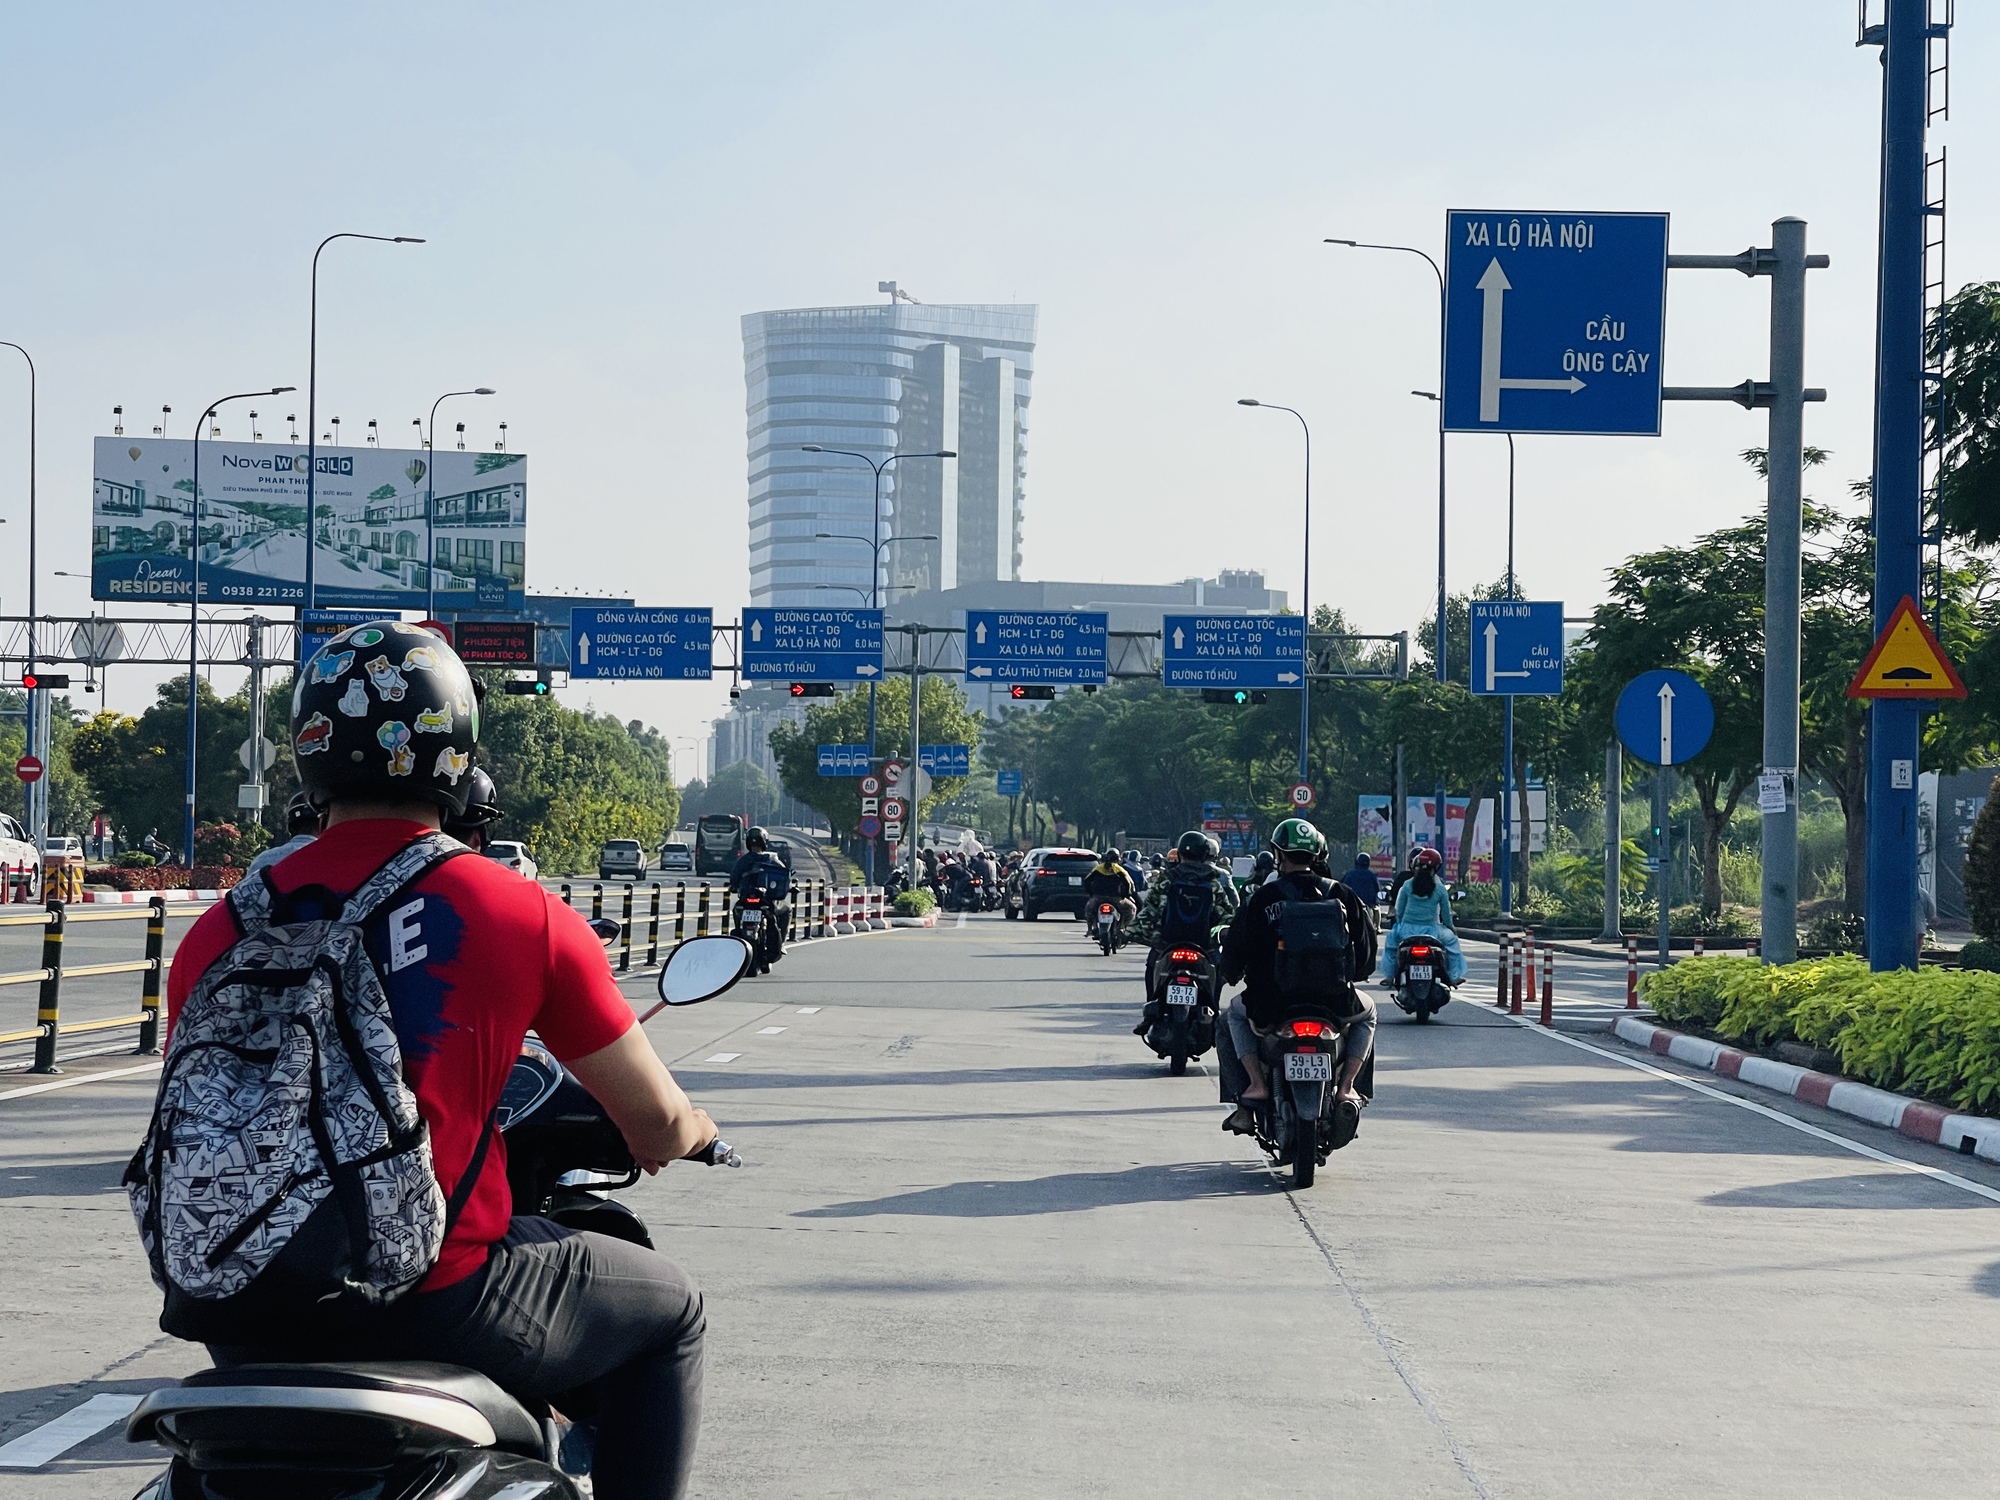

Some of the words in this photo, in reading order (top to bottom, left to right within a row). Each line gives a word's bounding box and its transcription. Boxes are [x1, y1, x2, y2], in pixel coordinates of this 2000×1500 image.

[1466, 222, 1490, 247] XA
[1496, 218, 1521, 251] LỘ
[1527, 217, 1554, 248] HÀ
[1560, 219, 1594, 253] NỘI
[1585, 314, 1626, 342] CẦU
[1562, 348, 1605, 373] ÔNG
[1611, 349, 1650, 377] CẬY
[258, 476, 286, 485] PHAN
[288, 477, 309, 486] THI
[134, 559, 182, 581] Ocean
[110, 579, 208, 595] RESIDENCE
[222, 586, 254, 596] 0938
[257, 587, 277, 597] 221
[281, 587, 304, 598] 226
[627, 612, 649, 624] VĂN
[651, 610, 679, 624] CỐNG
[684, 614, 696, 624] 4.0
[697, 614, 710, 624] km
[774, 611, 810, 623] ĐƯỜNG
[812, 613, 833, 623] CAO
[835, 610, 854, 623] TỐC
[1476, 606, 1487, 617] XA
[1489, 604, 1501, 619] LỘ
[1502, 604, 1514, 617] HÀ
[1516, 604, 1531, 619] NỘI
[855, 620, 867, 630] 4.5
[868, 620, 881, 630] km
[998, 613, 1034, 625] ĐƯỜNG
[1036, 615, 1057, 626] CAO
[1059, 613, 1078, 626] TỐC
[1195, 617, 1231, 630] ĐƯỜNG
[1233, 620, 1254, 630] CAO
[1256, 617, 1275, 630] TỐC
[774, 625, 797, 635] HCM
[806, 625, 817, 635] LT
[826, 625, 840, 635] DG
[998, 629, 1020, 639] HCM
[1030, 629, 1042, 639] LT
[1050, 630, 1065, 639] DG
[1078, 624, 1090, 634] 4.5
[1092, 625, 1105, 635] km
[1275, 627, 1288, 637] 4.5
[1289, 627, 1302, 637] km
[596, 632, 632, 644] ĐƯỜNG
[634, 634, 655, 644] CAO
[657, 631, 677, 644] TỐC
[775, 638, 788, 648] XA
[790, 636, 804, 650] LỘ
[806, 636, 820, 648] HÀ
[823, 638, 840, 650] NỘI
[854, 639, 867, 649] 6.0
[868, 639, 881, 649] km
[1195, 633, 1218, 642] HCM
[1227, 633, 1238, 643] LT
[1248, 633, 1262, 643] DG
[596, 646, 619, 657] HCM
[628, 647, 640, 657] LT
[649, 647, 663, 657] DG
[683, 641, 696, 651] 4.5
[697, 641, 710, 651] km
[999, 645, 1012, 655] XA
[1014, 643, 1028, 657] LỘ
[1030, 644, 1044, 656] HÀ
[1047, 644, 1064, 657] NỘI
[1076, 646, 1088, 656] 6.0
[1089, 647, 1102, 656] km
[1196, 646, 1209, 655] XA
[1211, 644, 1225, 657] LỘ
[1227, 644, 1241, 656] HÀ
[1244, 644, 1262, 657] NỘI
[1275, 646, 1288, 656] 6.0
[1289, 646, 1302, 656] km
[1531, 644, 1549, 656] CẦU
[750, 661, 782, 673] ĐƯỜNG
[783, 660, 795, 673] TỐ
[796, 661, 816, 673] HỮU
[1522, 658, 1541, 669] ÔNG
[1543, 658, 1560, 670] CẬY
[597, 667, 610, 677] XA
[613, 664, 626, 678] LỘ
[628, 664, 642, 677] HÀ
[645, 664, 663, 678] NỘI
[683, 667, 696, 677] 6.0
[697, 667, 710, 677] km
[998, 664, 1018, 677] CẦU
[1020, 664, 1041, 677] THỦ
[1078, 668, 1090, 678] 2.0
[1091, 669, 1104, 679] km
[1171, 668, 1203, 680] ĐƯỜNG
[1205, 667, 1217, 680] TỐ
[1217, 668, 1237, 680] HỮU
[865, 780, 875, 791] 60
[1296, 789, 1308, 802] 50
[887, 805, 899, 816] 80
[1168, 994, 1195, 1005] 39393
[1291, 1055, 1324, 1067] 59-L3
[1289, 1067, 1327, 1079] 396.28
